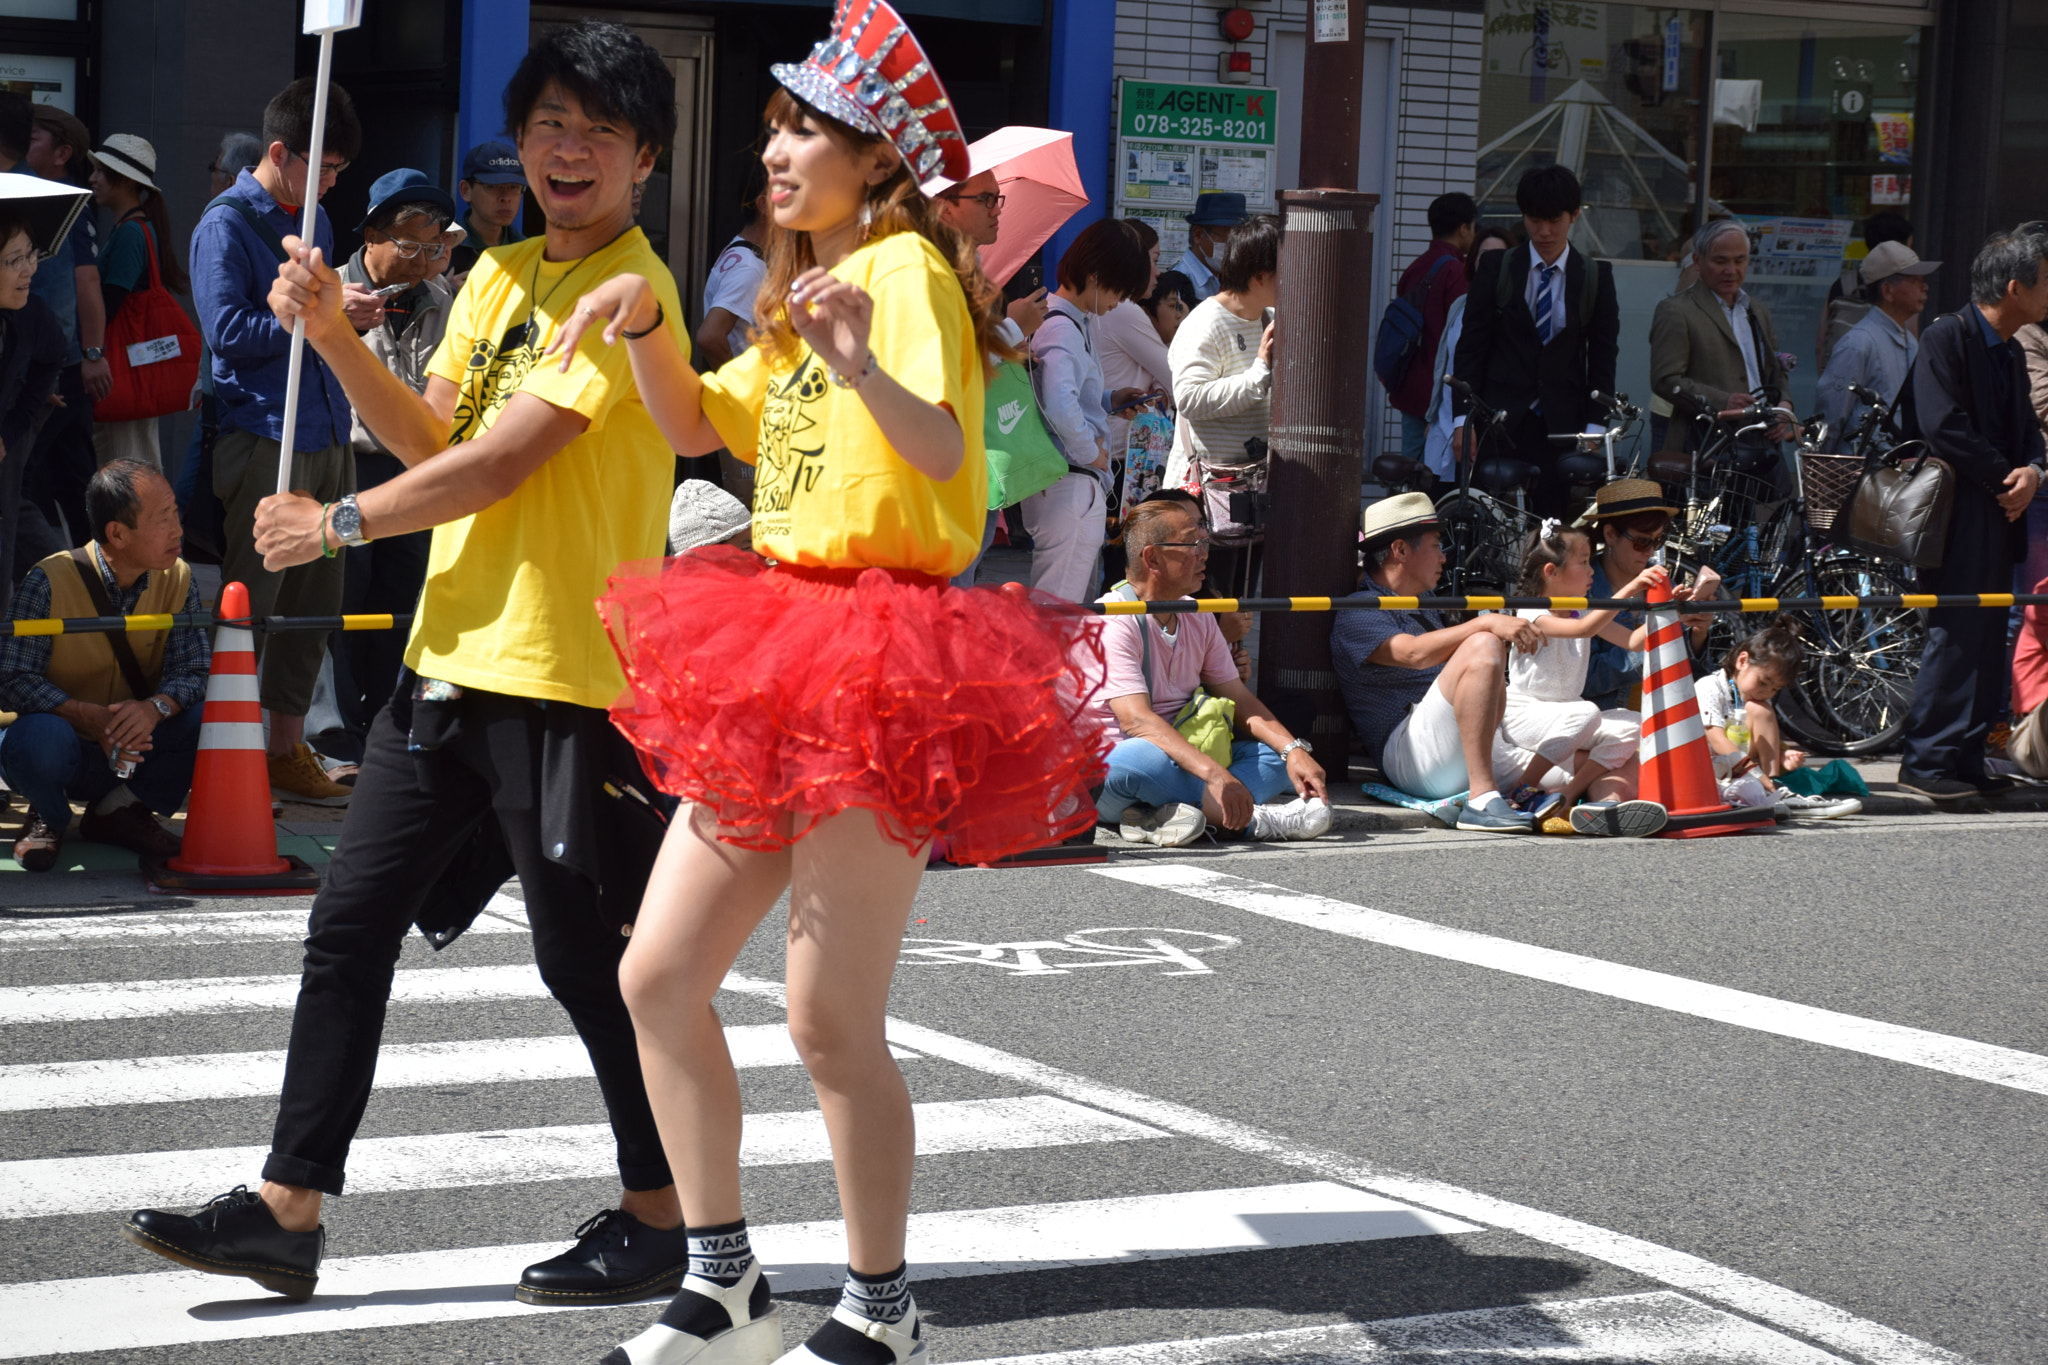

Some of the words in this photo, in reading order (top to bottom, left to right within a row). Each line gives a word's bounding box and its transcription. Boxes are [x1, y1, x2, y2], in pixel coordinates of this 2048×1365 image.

[1157, 89, 1265, 117] AGENT-K
[1134, 114, 1266, 140] 078-325-8201
[488, 157, 520, 167] adidas
[997, 399, 1020, 423] NIKE
[753, 521, 791, 541] Tigers
